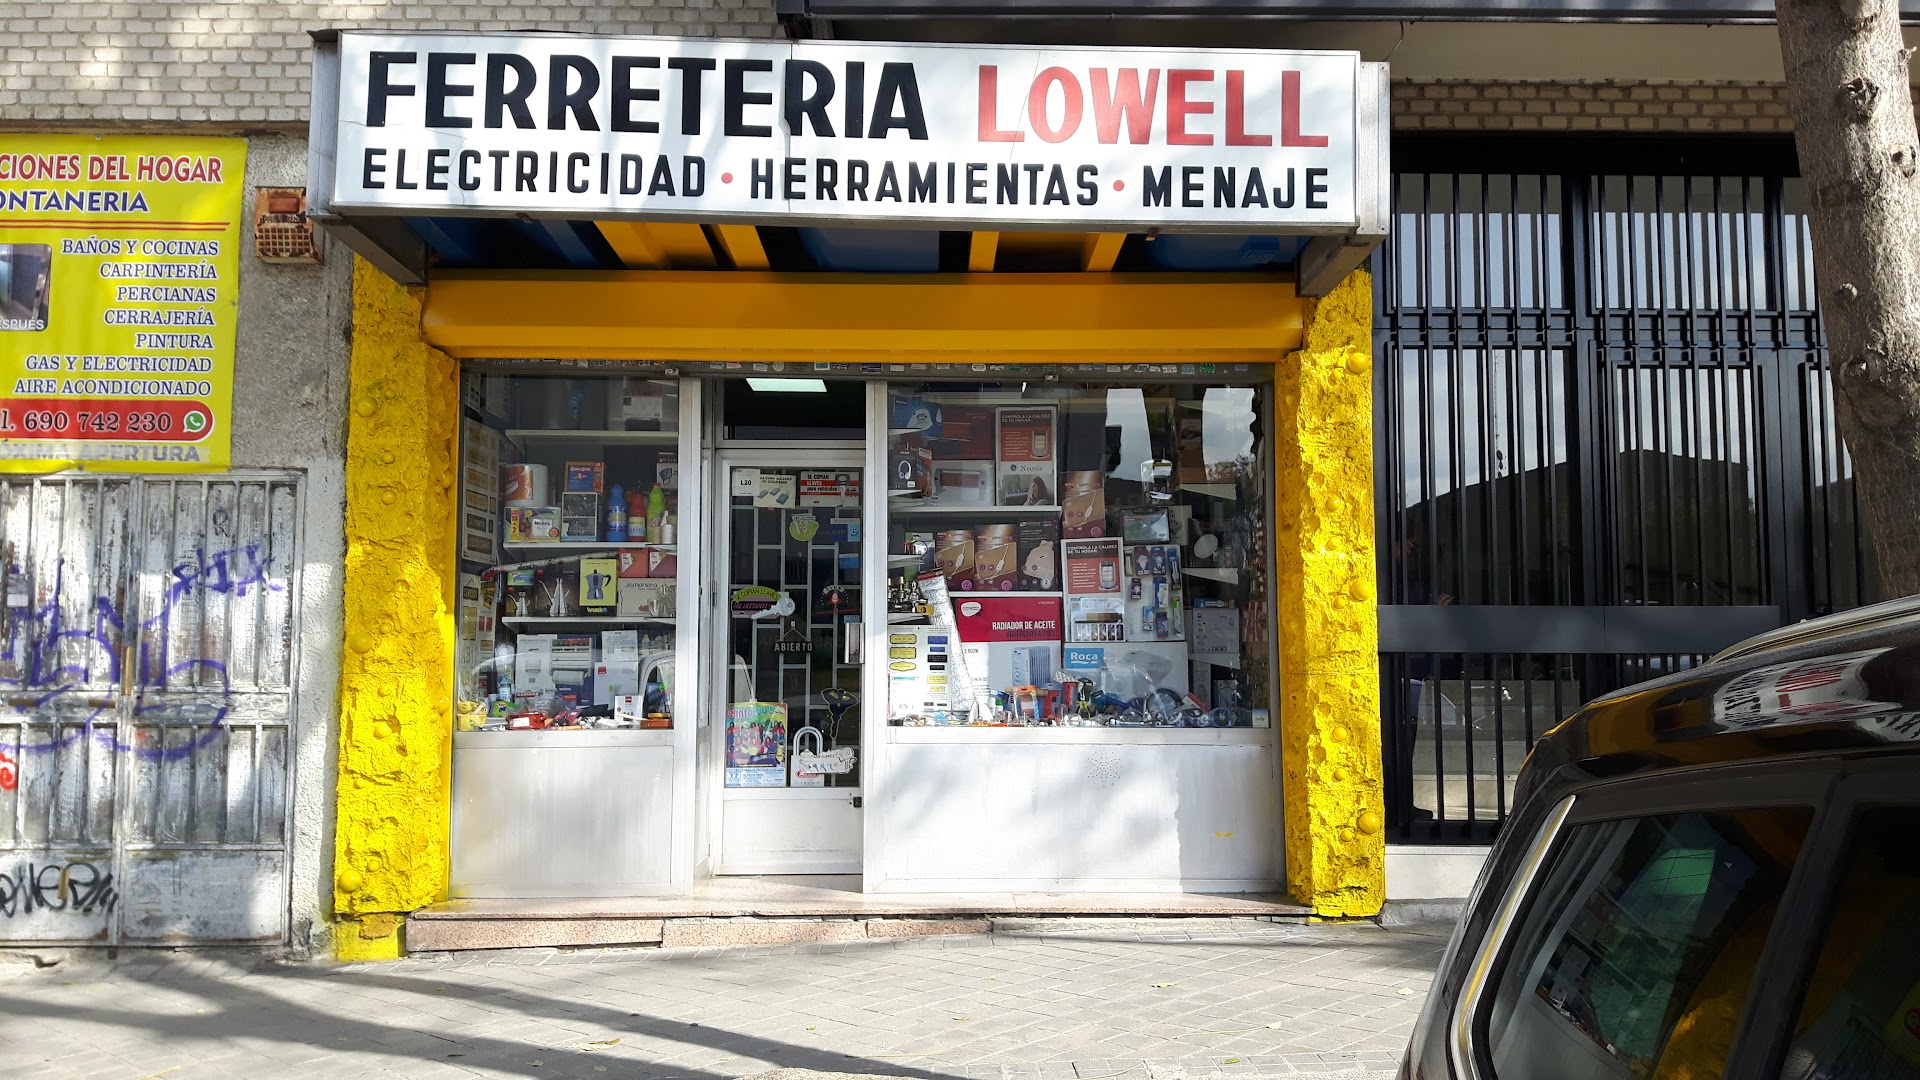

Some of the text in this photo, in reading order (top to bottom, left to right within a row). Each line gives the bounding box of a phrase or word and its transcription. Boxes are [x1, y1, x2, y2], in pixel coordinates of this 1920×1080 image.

[366, 51, 1329, 148] FERRETERIA LOWELL
[0, 153, 224, 184] CIONES DEL HOGAR
[362, 147, 1329, 209] ELECTRICIDAD HERRAMIENTAS MENAJE
[61, 236, 219, 257] BAÑOS Y COCINAS
[99, 260, 218, 280] CARPINTERÍA
[116, 285, 217, 303] PERCIANAS
[104, 306, 216, 326] CERRAJERÍA
[134, 332, 214, 350] PINTURA
[25, 354, 213, 373] GAS Y ELECTRICIDAD
[13, 378, 212, 397] AIRE ACONDICIONADO
[23, 409, 69, 432] 690
[76, 411, 120, 433] 742
[126, 412, 173, 434] 230
[992, 620, 1056, 631] RADIADOR DE ACEITE
[774, 642, 813, 652] ABIERTO
[1070, 651, 1099, 661] Roca
